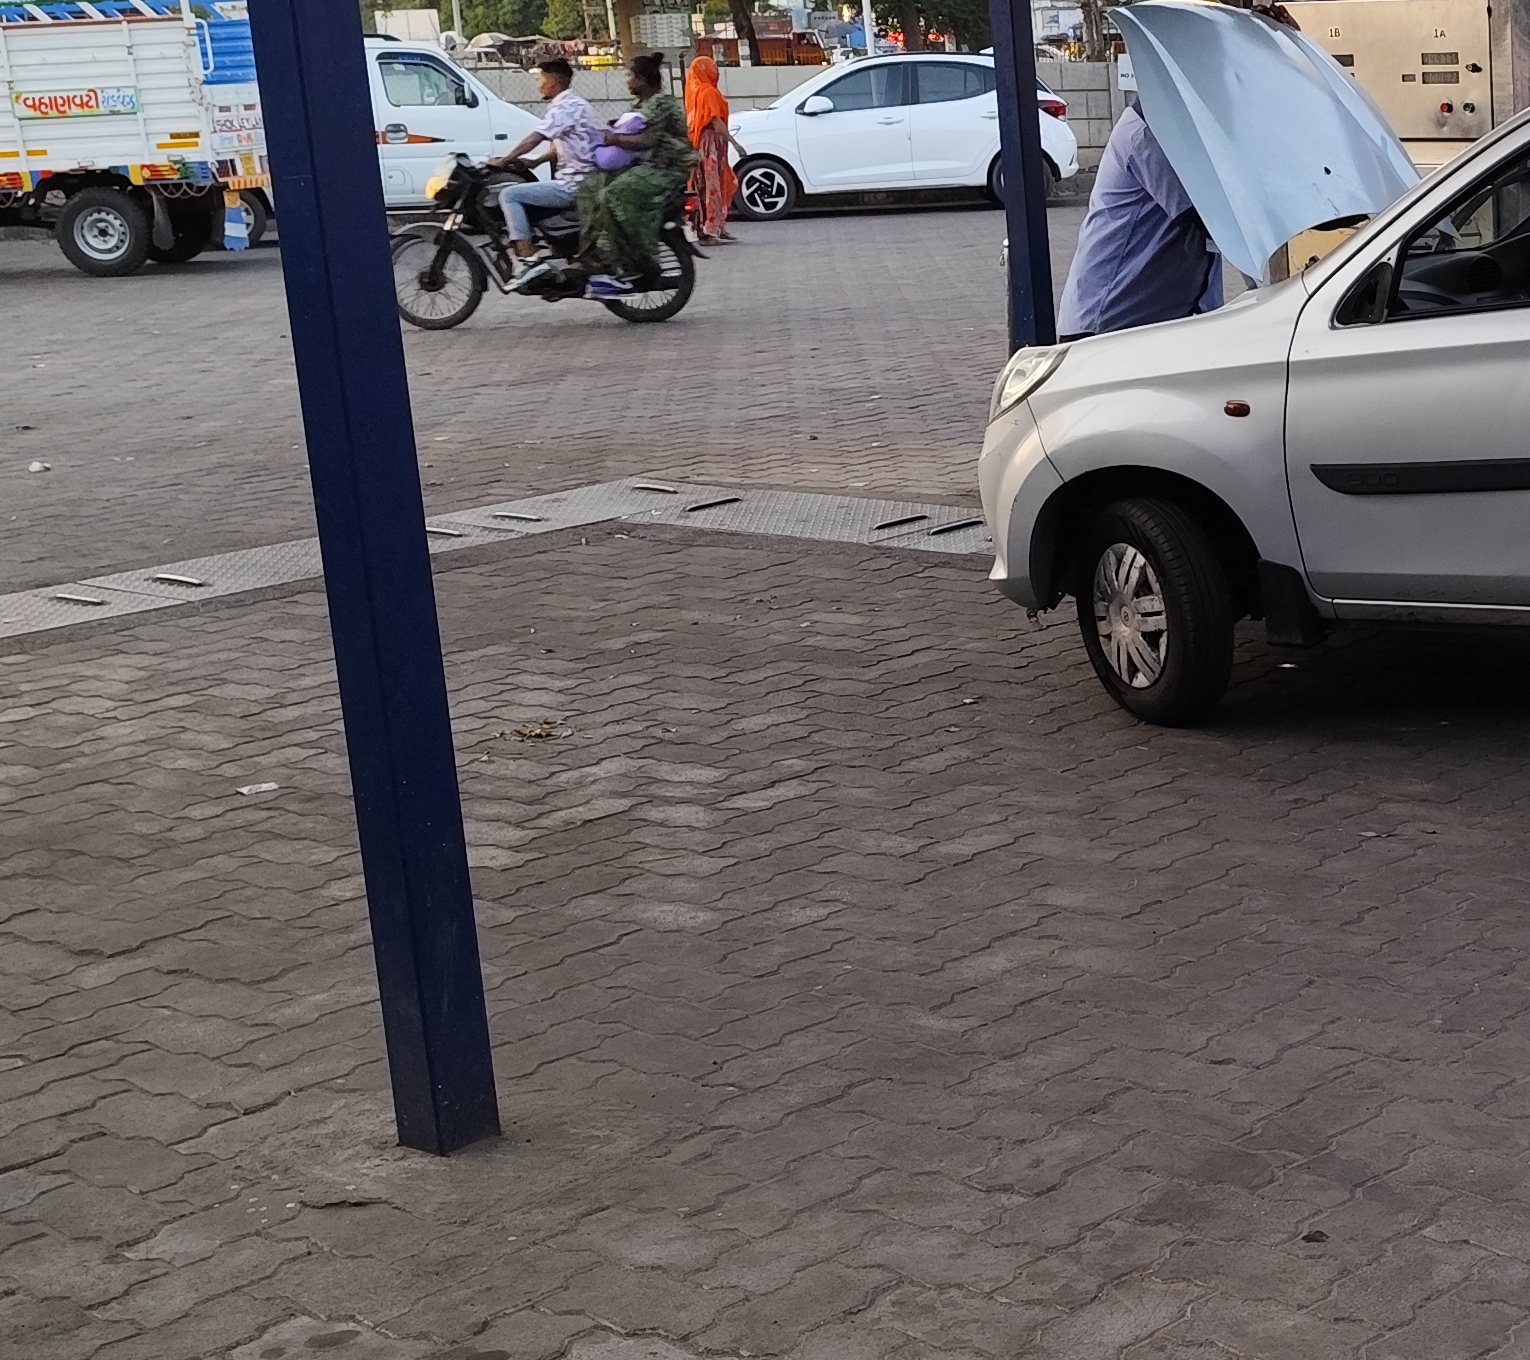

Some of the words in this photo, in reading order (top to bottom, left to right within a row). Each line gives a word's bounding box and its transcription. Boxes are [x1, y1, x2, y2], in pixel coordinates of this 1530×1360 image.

[1329, 27, 1341, 38] 1B
[1434, 28, 1447, 39] 1A
[22, 89, 99, 115] વહાણવટી
